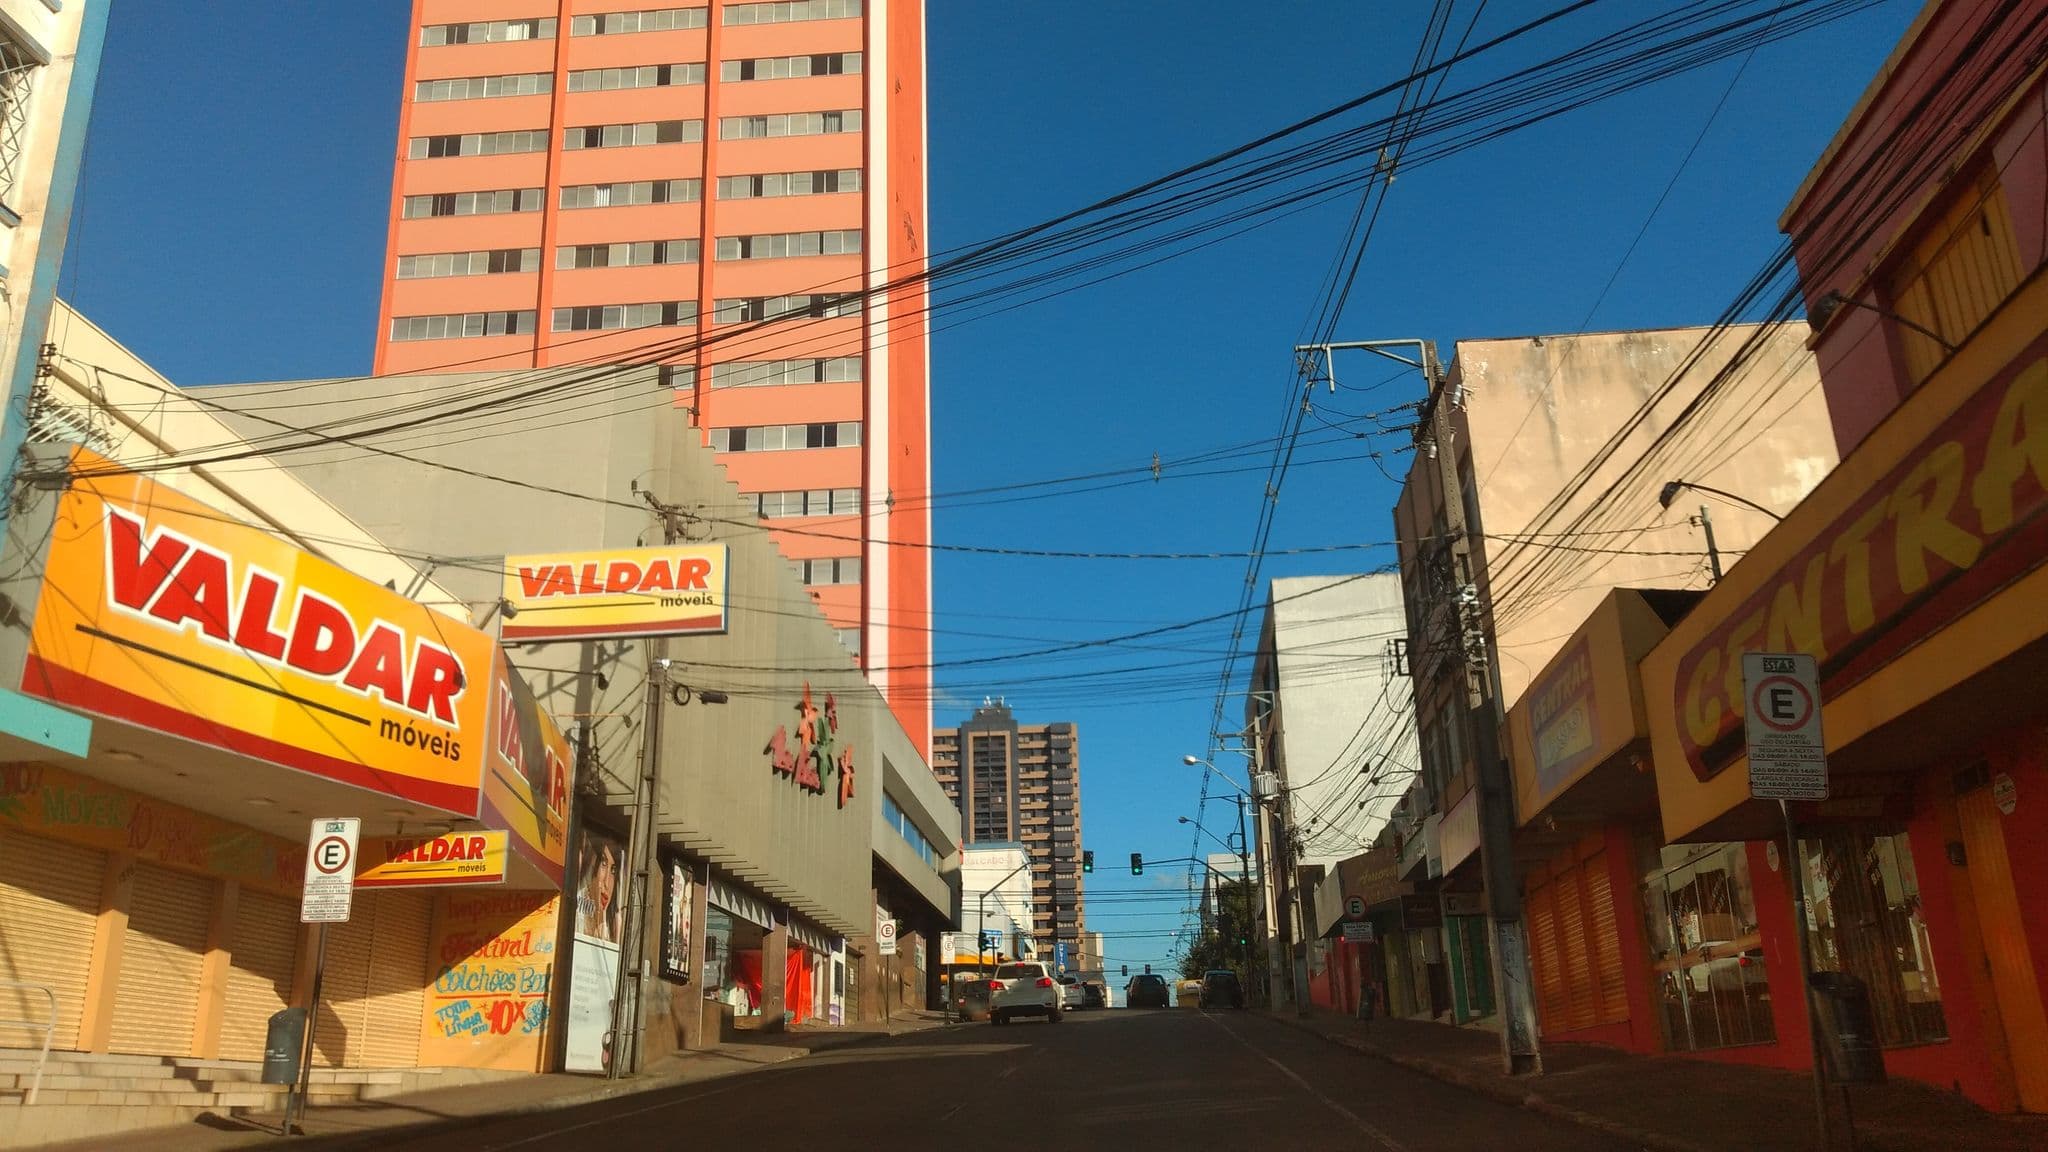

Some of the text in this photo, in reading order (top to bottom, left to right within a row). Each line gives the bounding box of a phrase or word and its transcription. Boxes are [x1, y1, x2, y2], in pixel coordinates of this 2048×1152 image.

[519, 557, 712, 598] VALDAR
[660, 592, 714, 608] móveis
[105, 506, 467, 727] VALDAR
[1763, 657, 1796, 673] ESTAR
[1770, 688, 1796, 719] E
[380, 716, 461, 762] móveis
[324, 844, 340, 865] E
[384, 836, 487, 863] VALDAR
[458, 862, 487, 873] móveis
[1351, 900, 1361, 914] E
[885, 927, 891, 935] E
[440, 930, 554, 962] Festival de
[435, 962, 517, 994] Colchões
